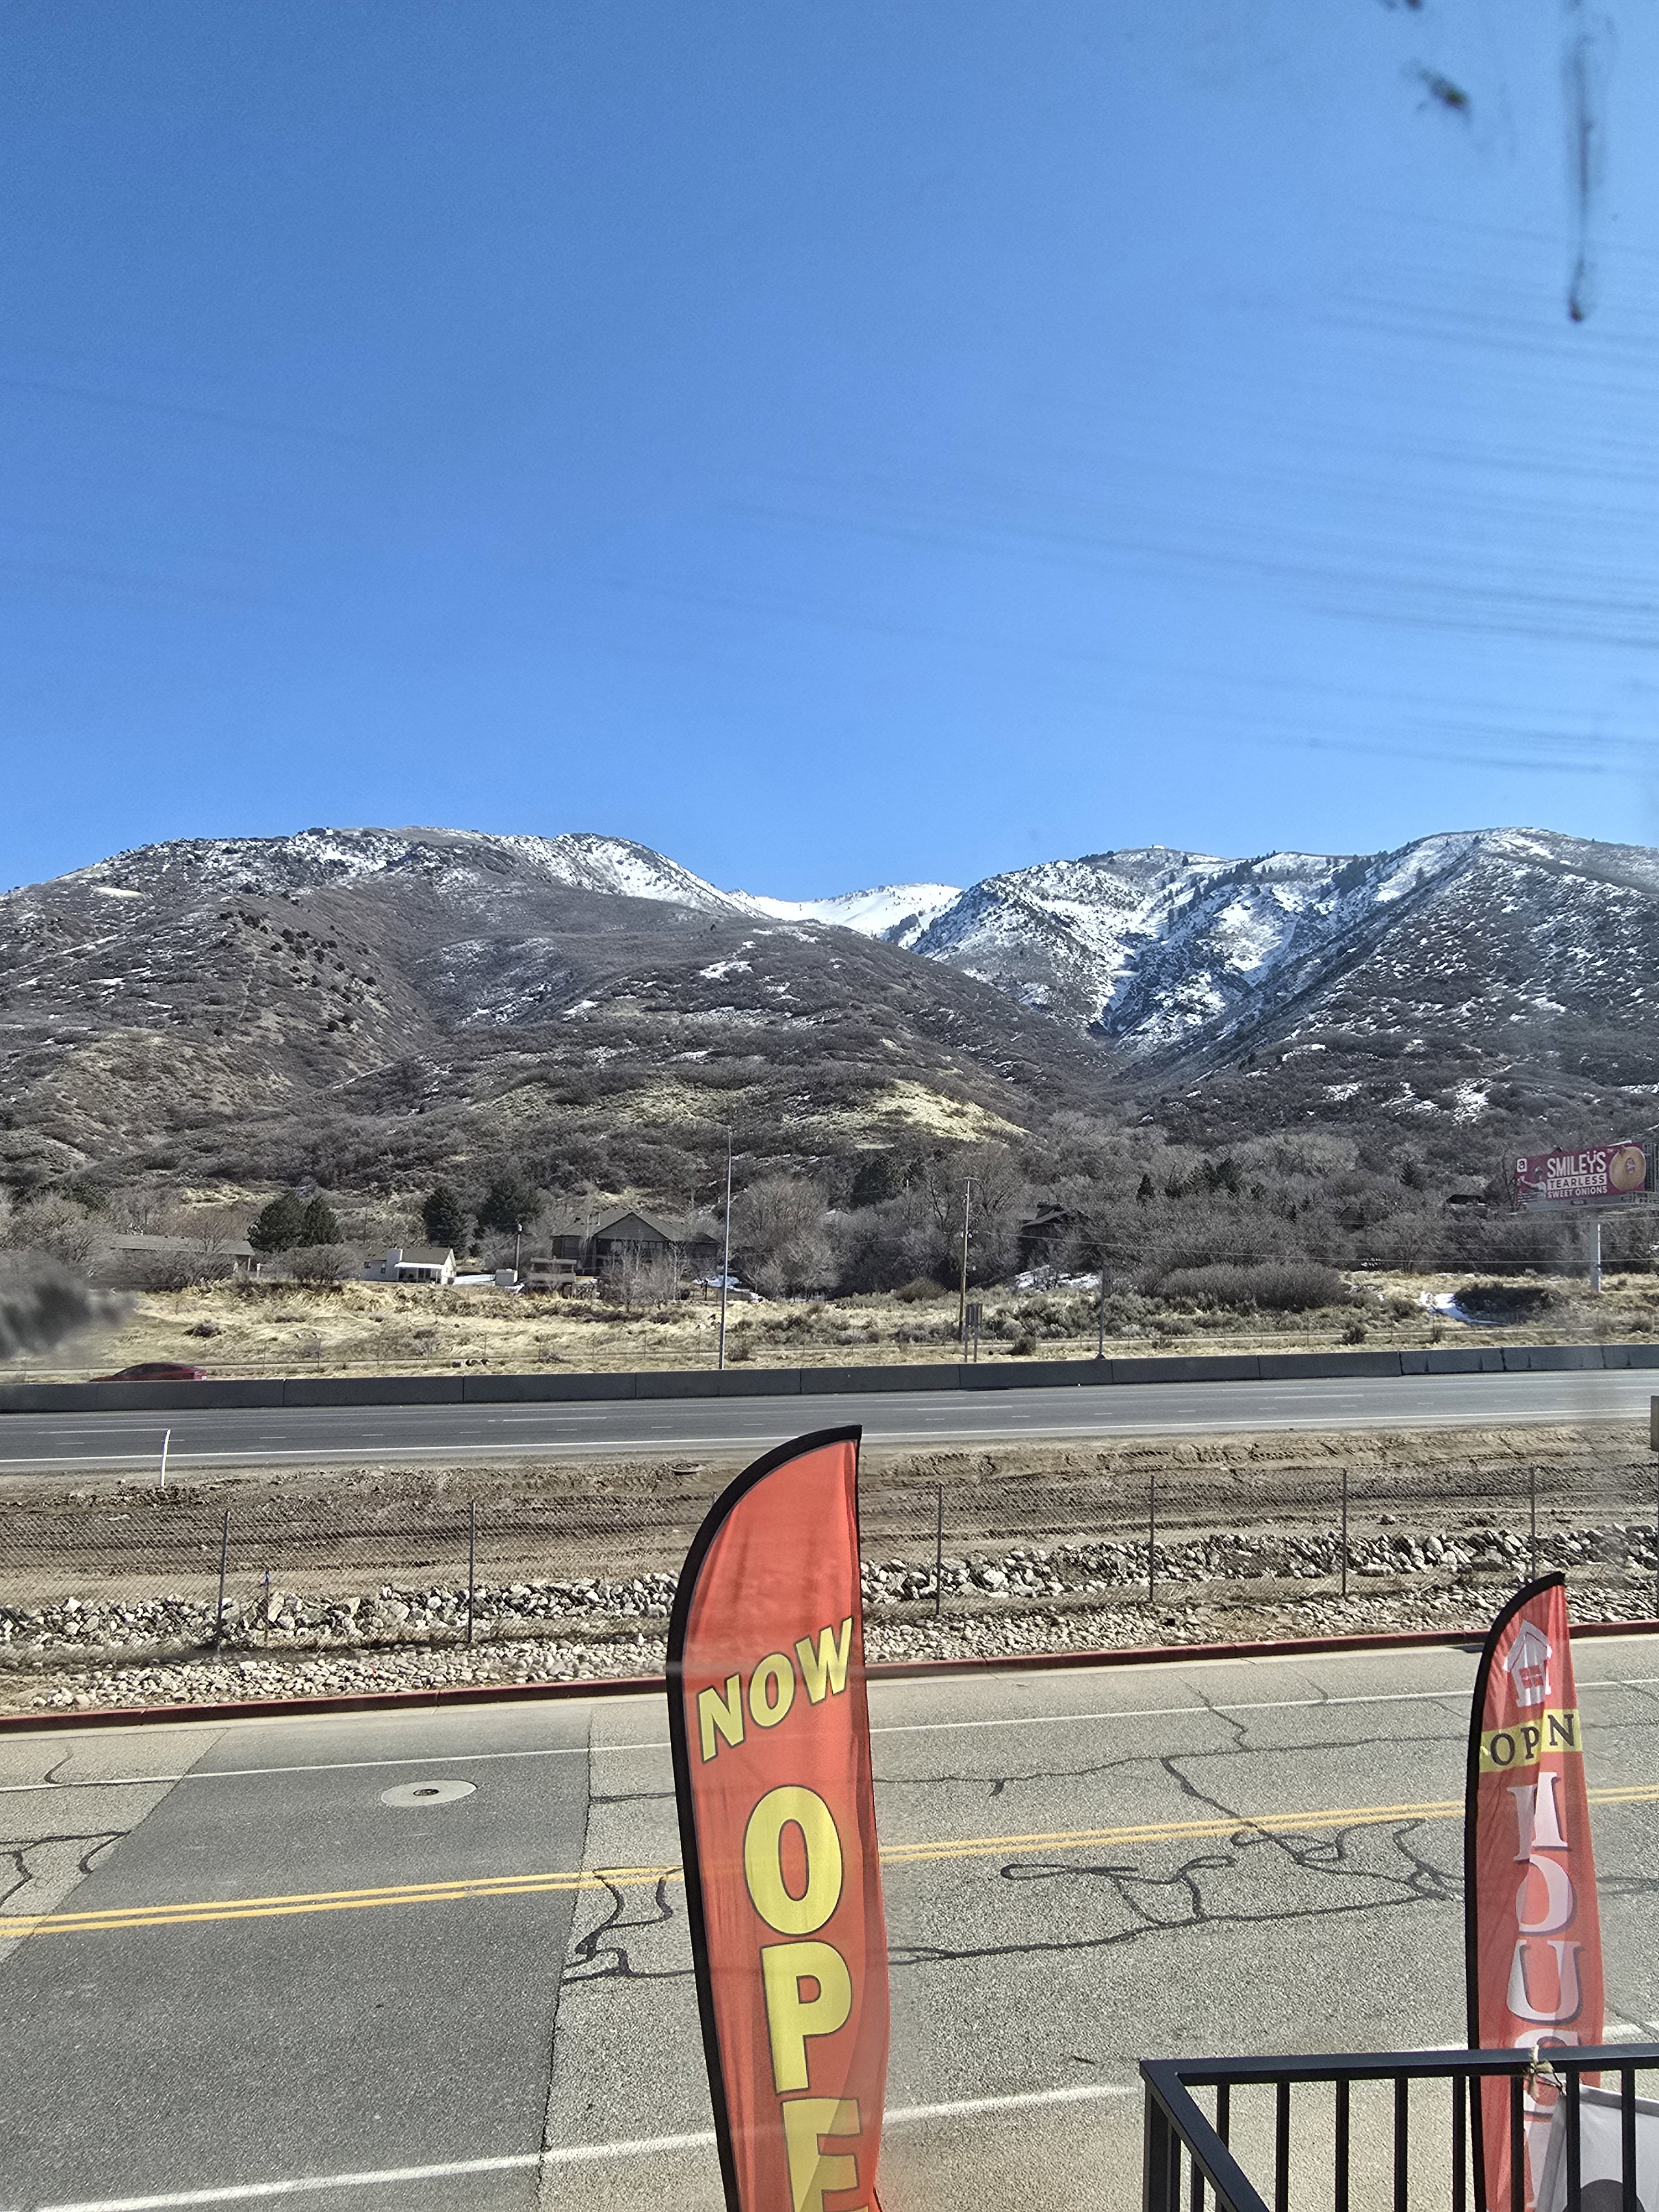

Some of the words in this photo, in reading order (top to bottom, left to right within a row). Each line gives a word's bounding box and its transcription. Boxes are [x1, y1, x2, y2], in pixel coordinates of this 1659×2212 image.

[1550, 1175, 1605, 1189] TEARLESS
[1547, 1189, 1573, 1199] SWEET
[1575, 1186, 1608, 1196] ONIONS
[697, 1616, 853, 1764] NOW
